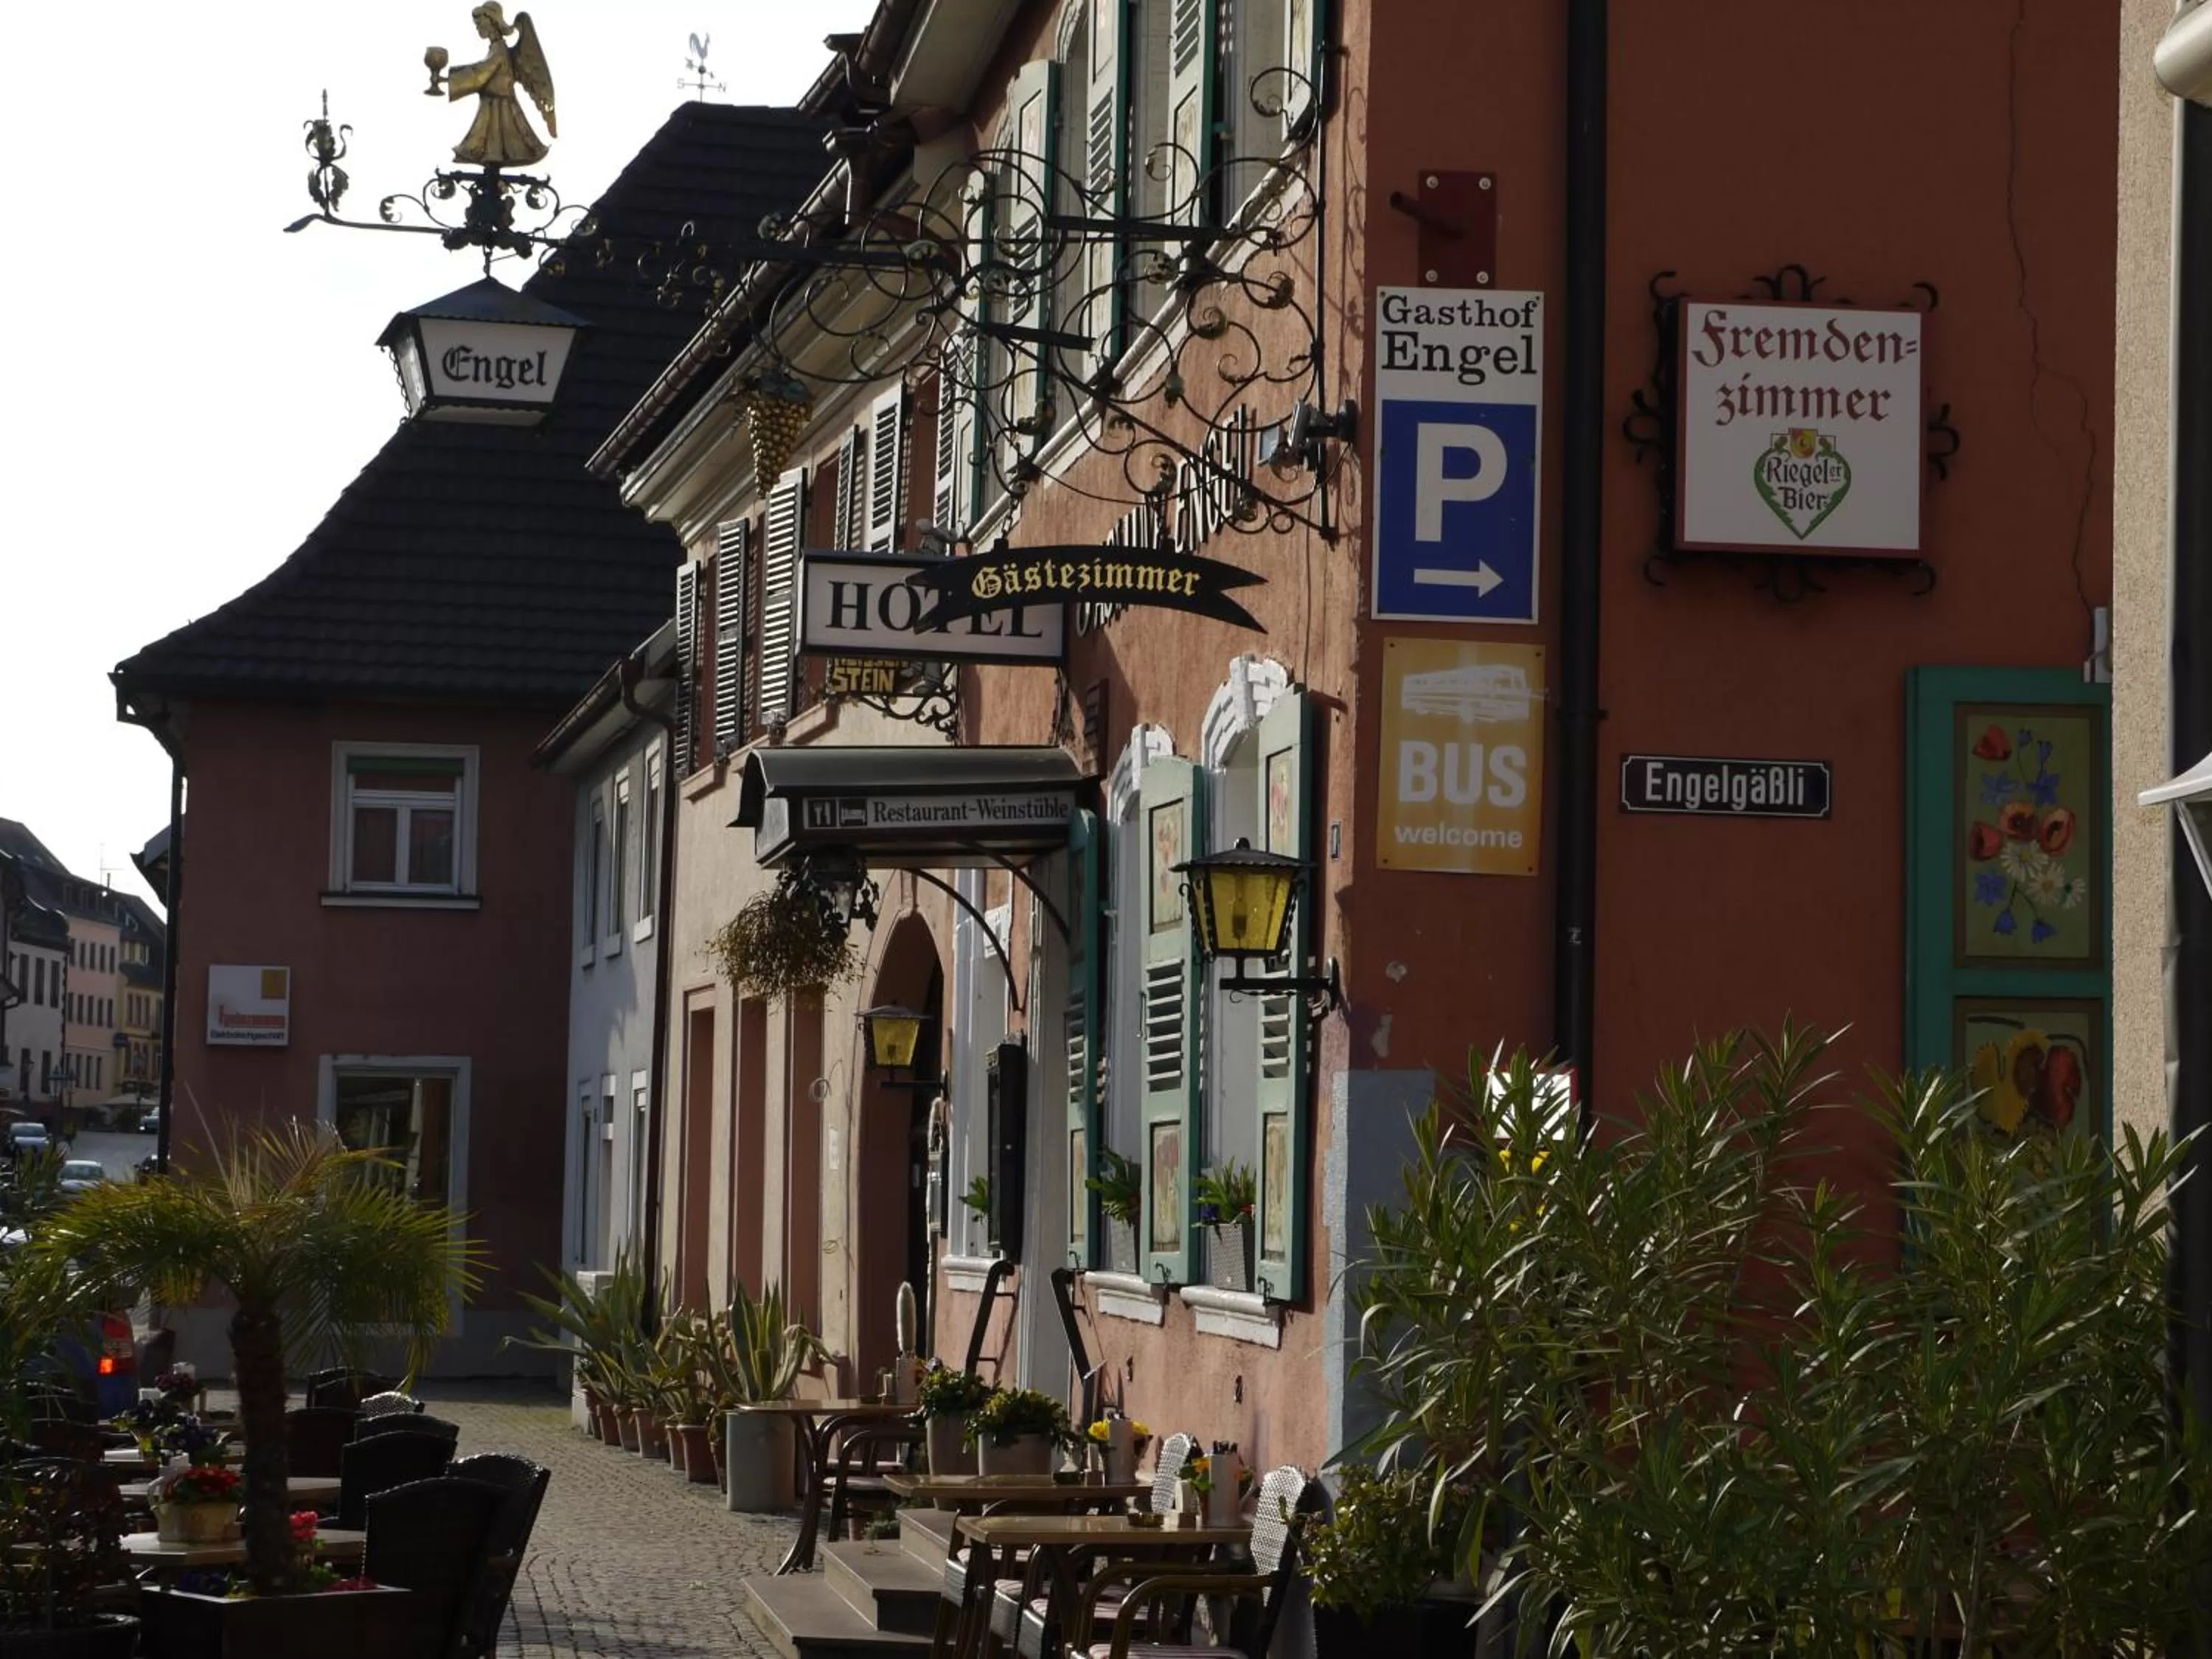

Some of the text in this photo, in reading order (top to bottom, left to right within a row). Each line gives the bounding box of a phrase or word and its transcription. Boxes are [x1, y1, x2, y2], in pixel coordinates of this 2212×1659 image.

[1382, 295, 1537, 328] Gasthof
[442, 345, 548, 389] Engel
[1381, 331, 1537, 386] Engel
[1715, 372, 1891, 426] zimmer
[1415, 422, 1508, 543] P
[971, 558, 1201, 598] Gästezimmer
[832, 667, 894, 693] STEIN
[1399, 740, 1528, 808] BUS
[1645, 762, 1805, 811] Engelgäßli
[873, 796, 1069, 823] Restaurant-Weinstüble
[1394, 821, 1523, 849] welcome
